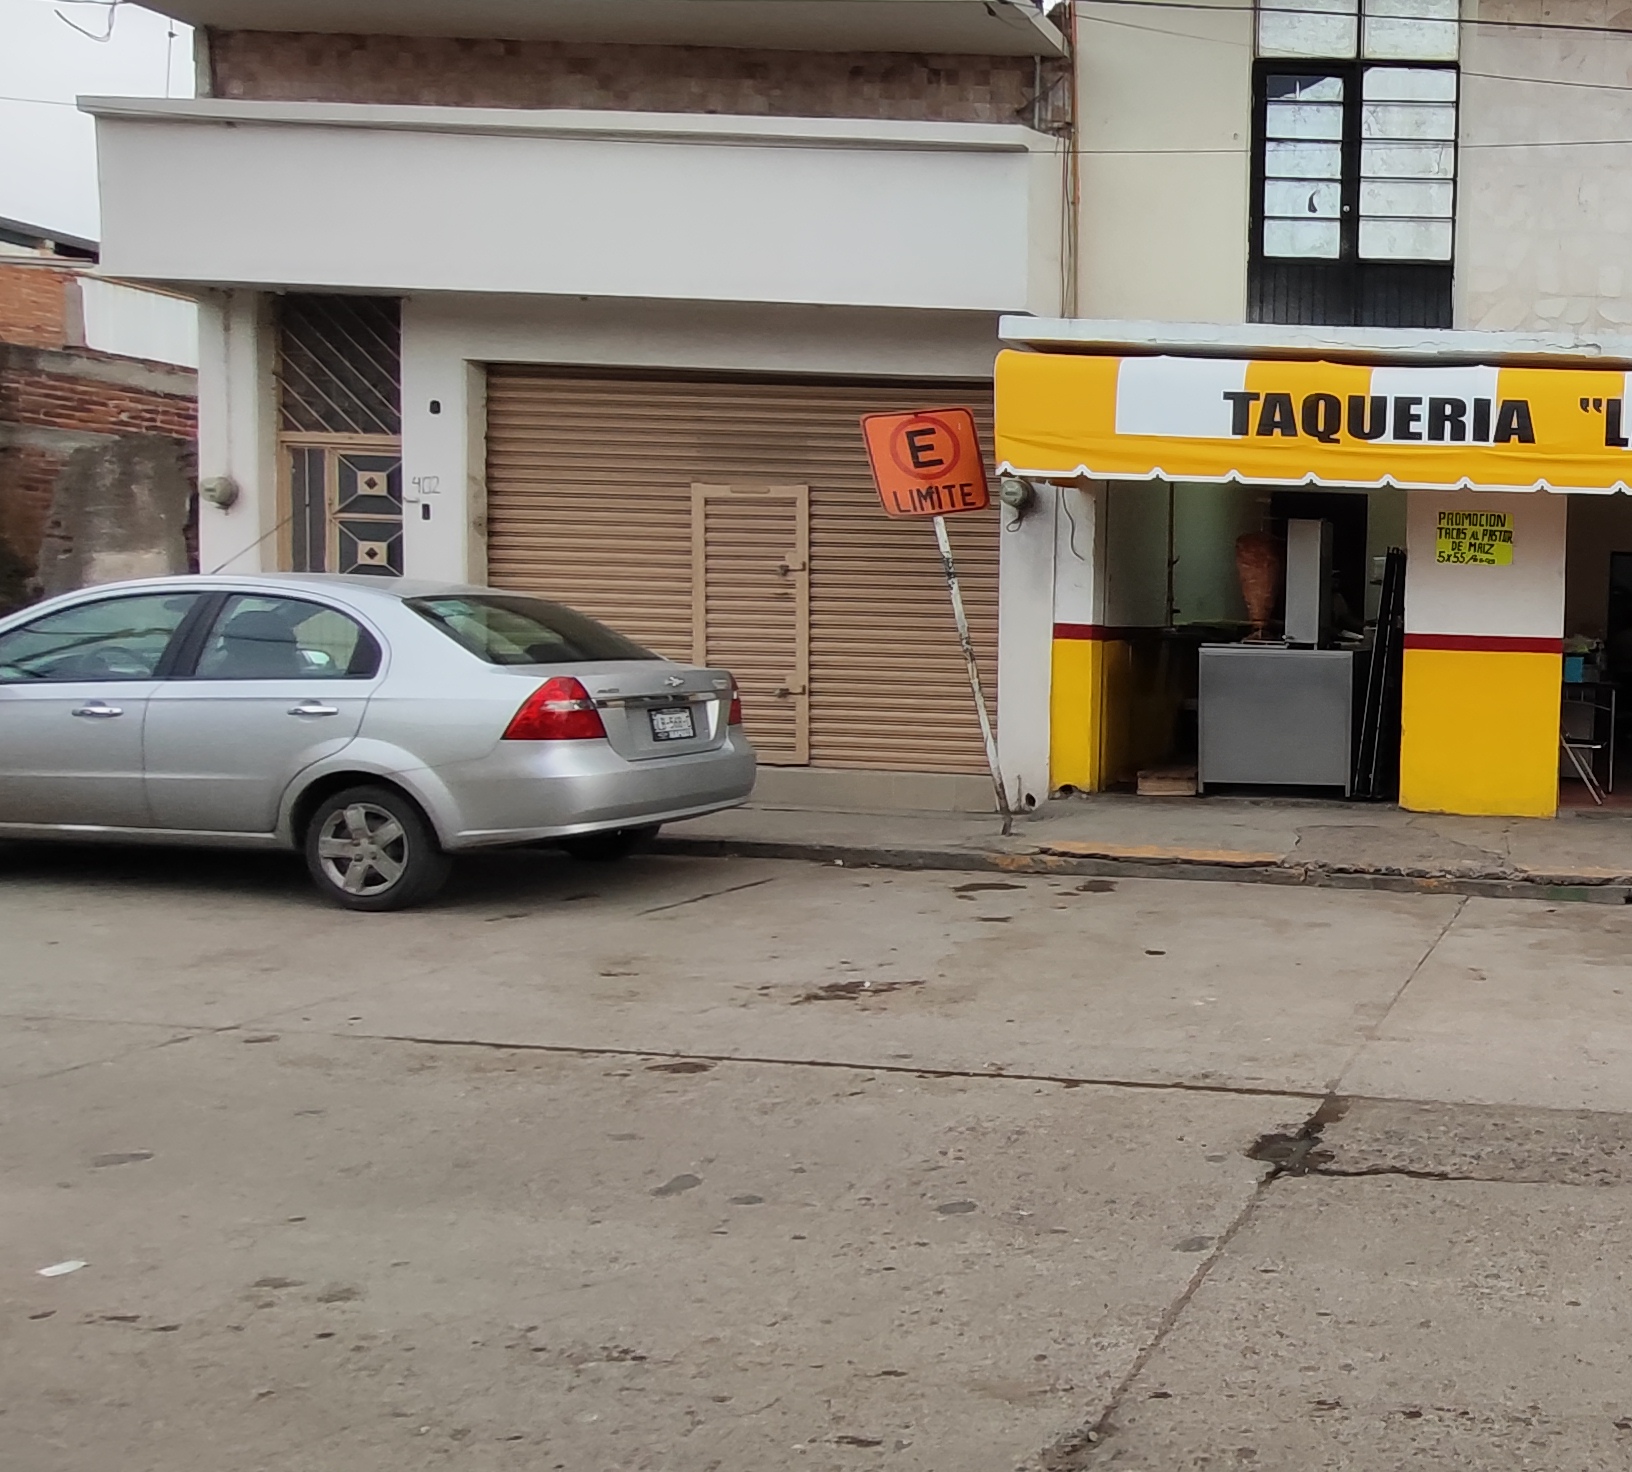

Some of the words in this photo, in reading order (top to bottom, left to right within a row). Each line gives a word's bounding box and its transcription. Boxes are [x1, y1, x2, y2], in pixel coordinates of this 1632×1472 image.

[1222, 391, 1536, 445] TAQUERIA
[905, 427, 945, 469] E
[411, 475, 441, 495] 402
[892, 482, 977, 513] LIMITE
[1438, 511, 1507, 527] PROMOCION
[1437, 527, 1468, 540] TACOS
[1469, 530, 1480, 541] AL
[1451, 541, 1464, 552] DE
[1468, 541, 1495, 555] MAIZ
